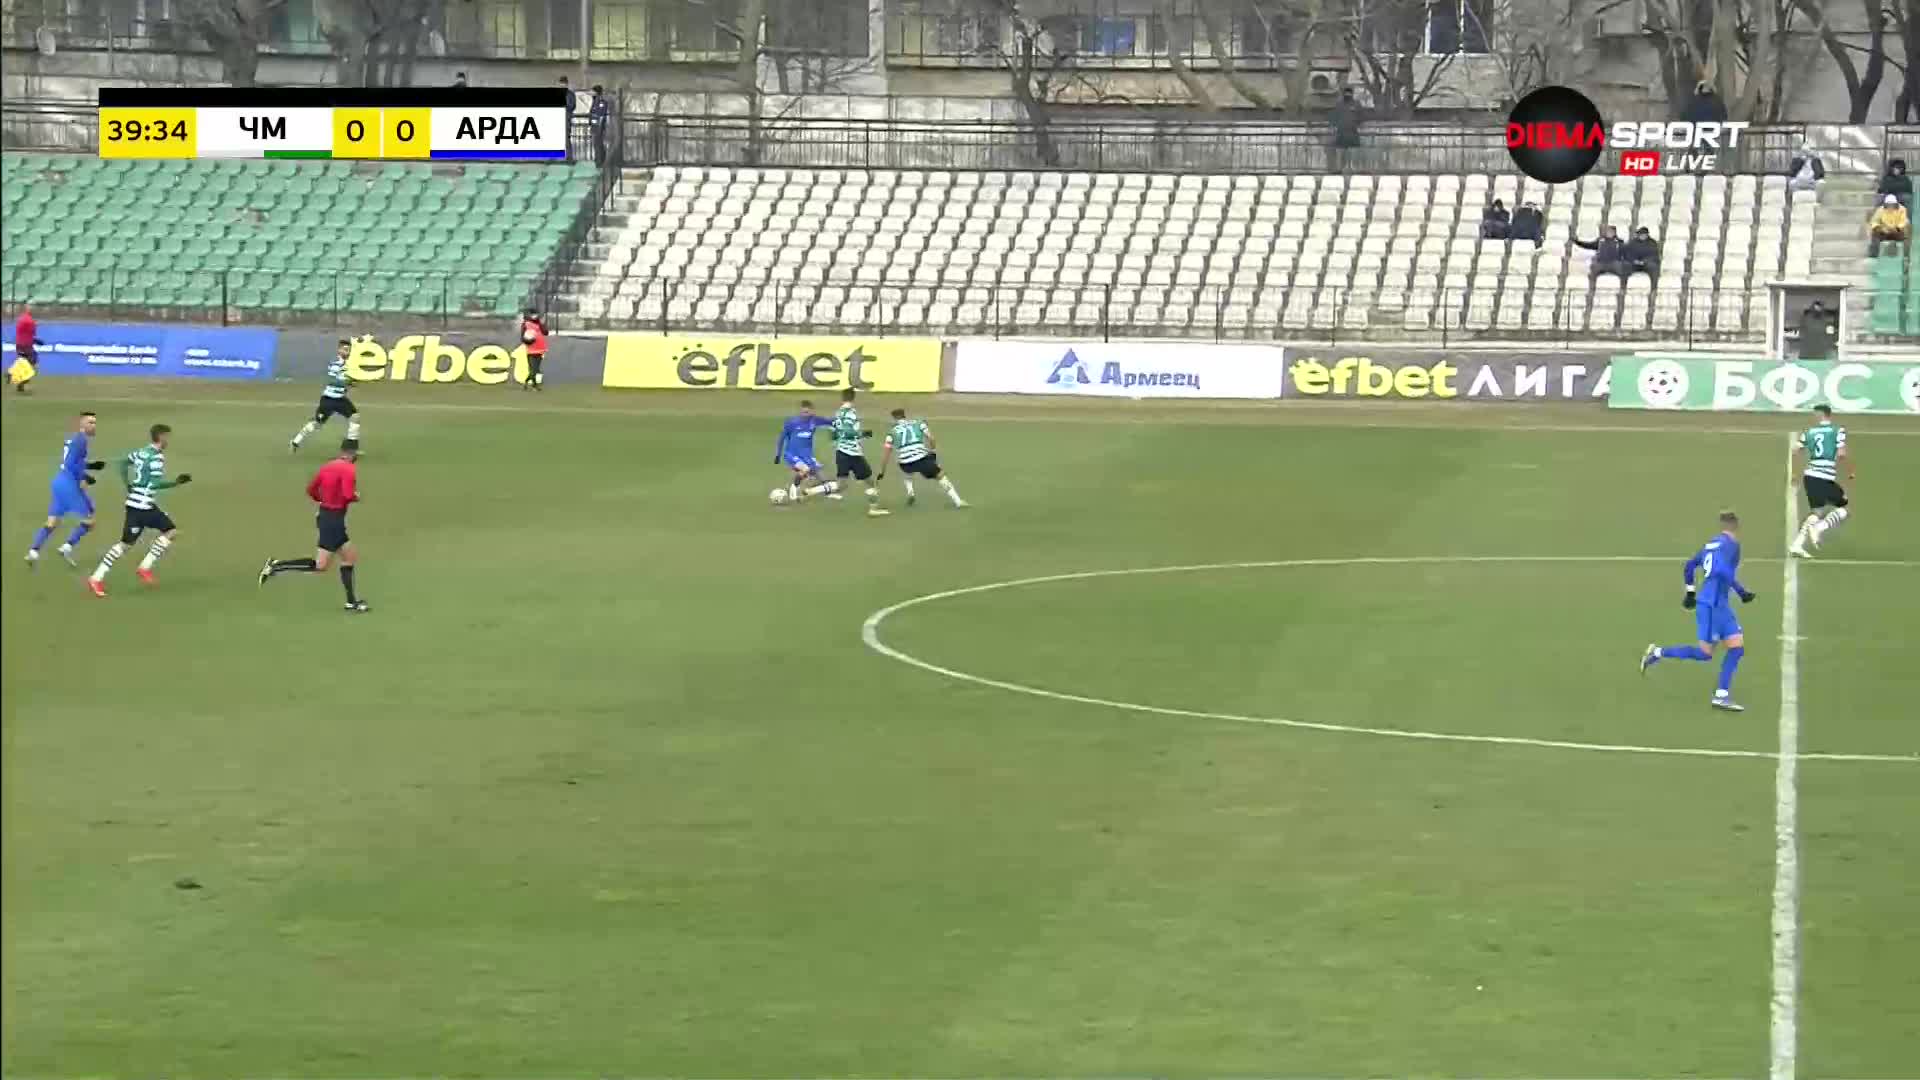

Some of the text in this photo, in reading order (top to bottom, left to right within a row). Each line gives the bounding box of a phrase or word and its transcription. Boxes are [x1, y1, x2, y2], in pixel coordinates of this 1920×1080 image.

[672, 343, 877, 390] efbet
[1100, 361, 1201, 390] Армеец
[1290, 356, 1457, 397] efbet
[1715, 361, 1873, 409] БФС
